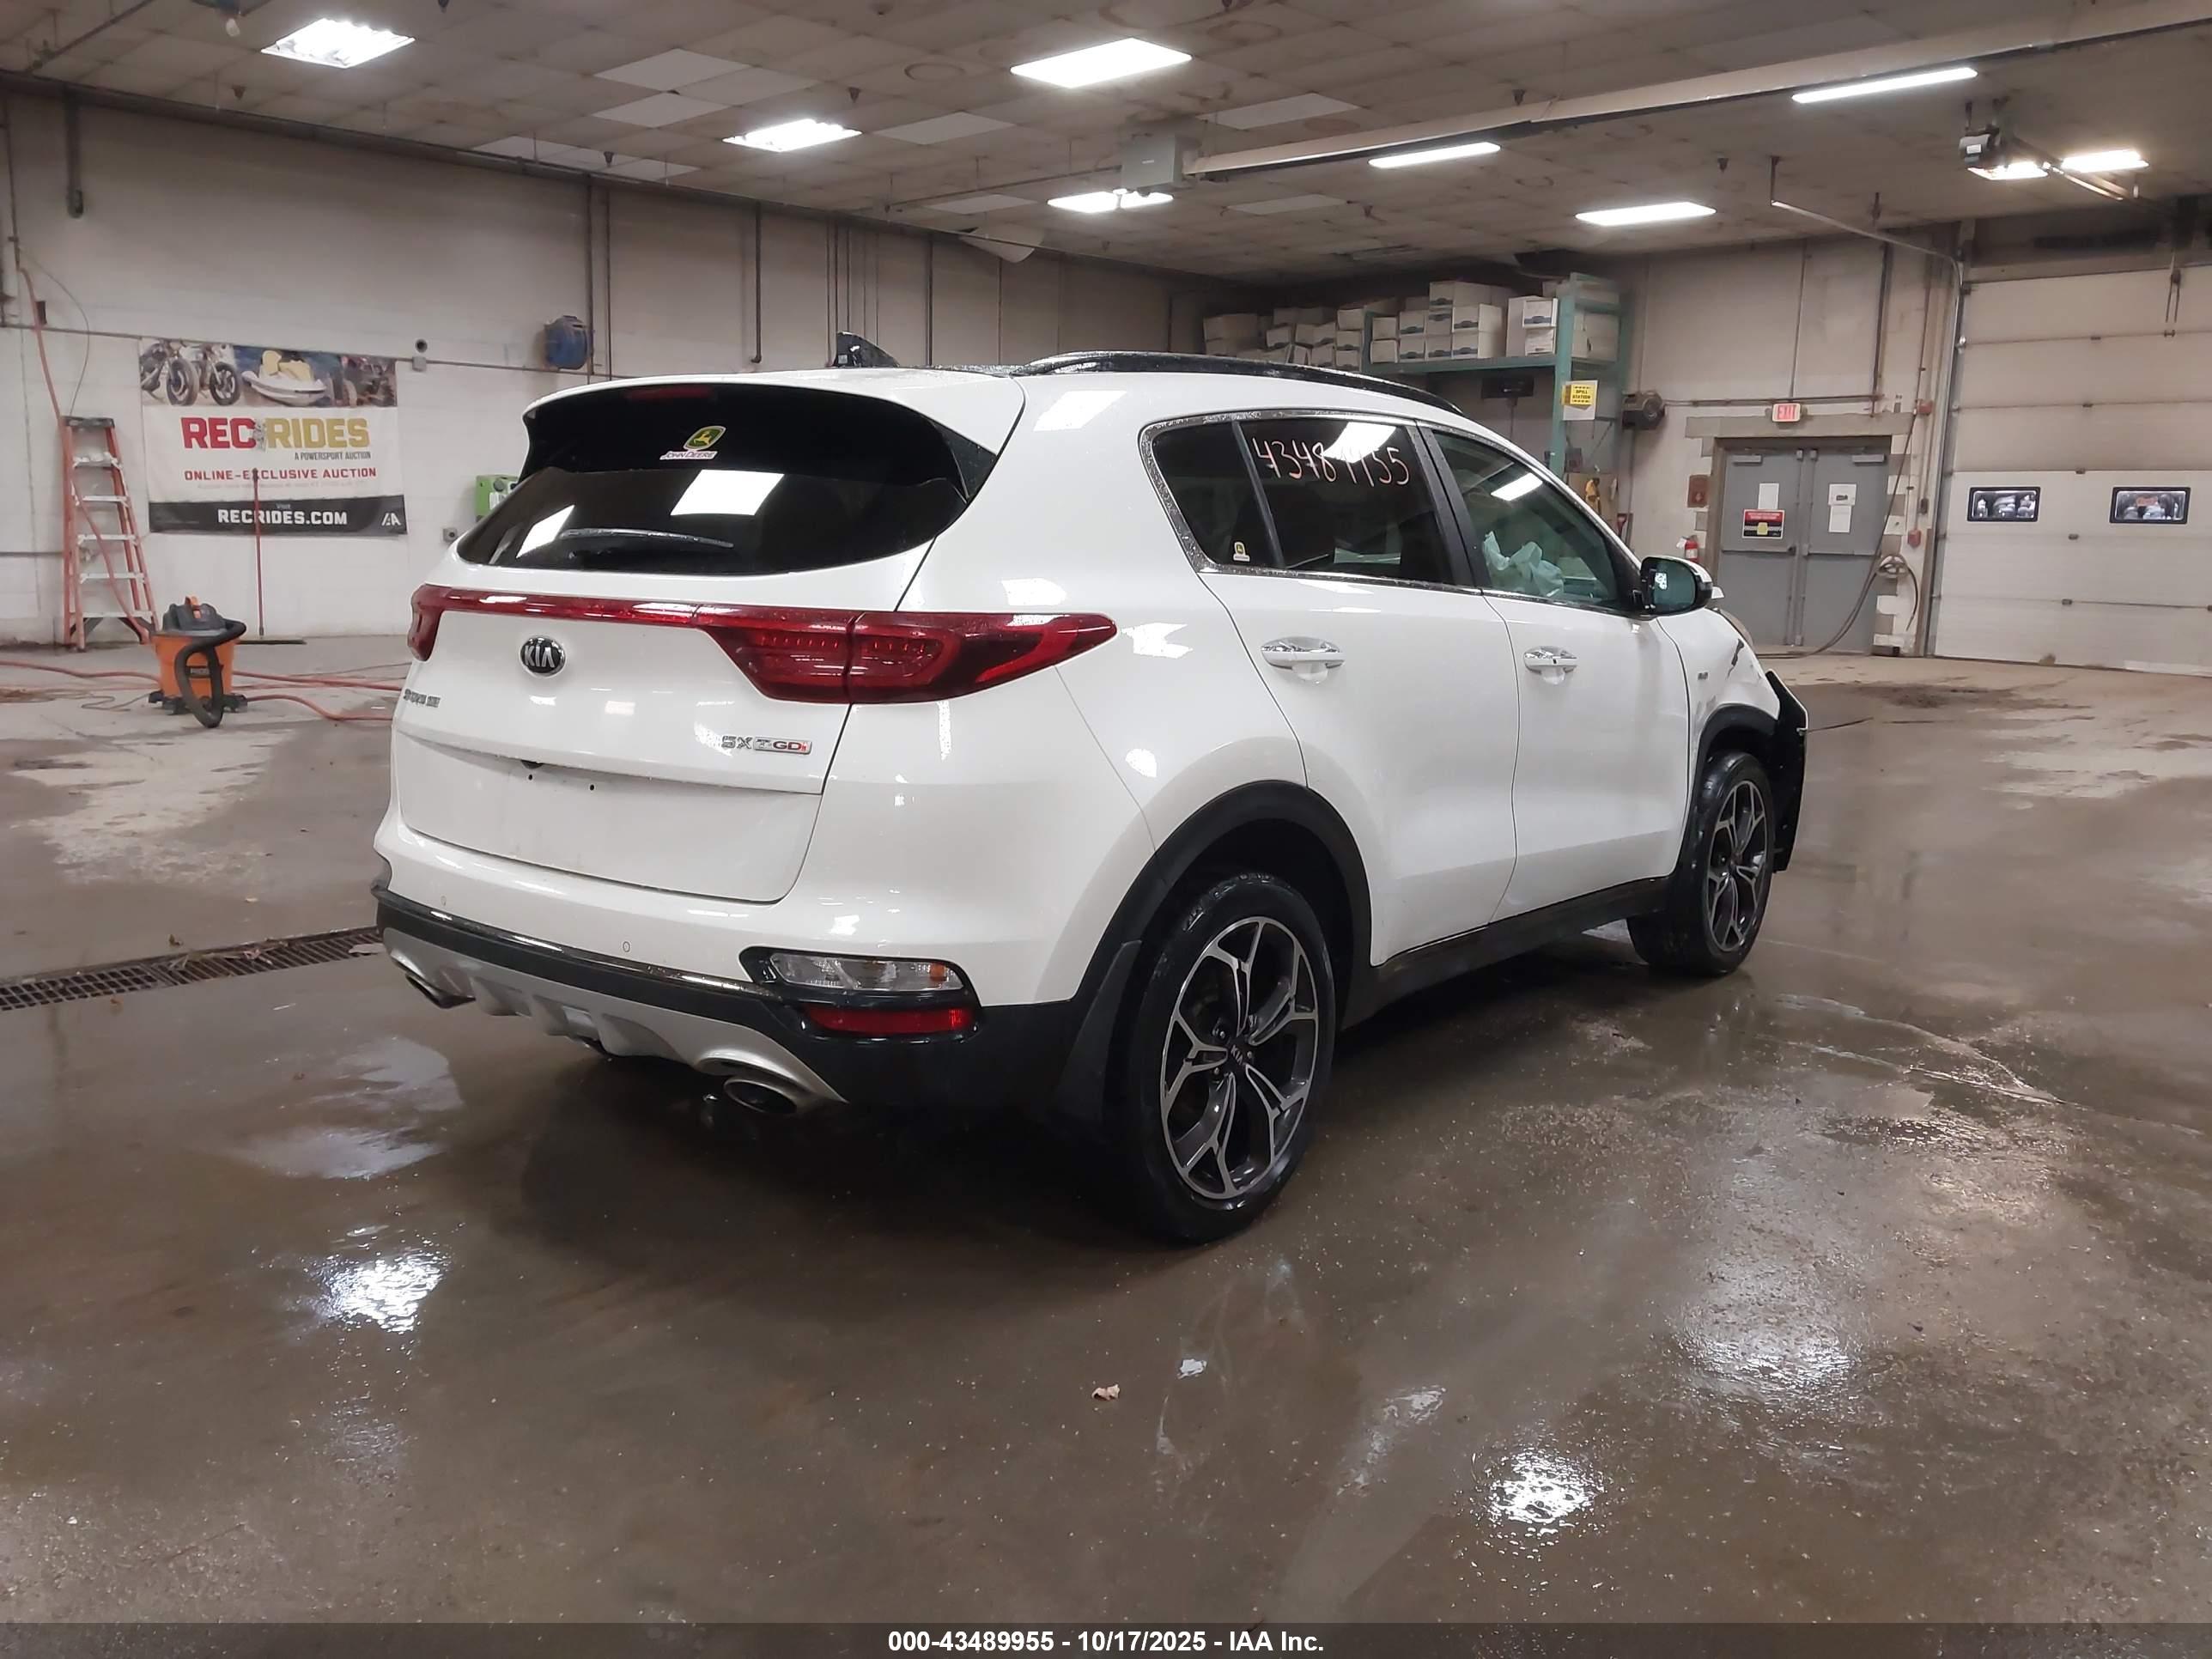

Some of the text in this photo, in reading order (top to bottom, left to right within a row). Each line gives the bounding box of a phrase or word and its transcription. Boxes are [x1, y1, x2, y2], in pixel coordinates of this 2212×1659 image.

[1777, 404, 1797, 420] EXIT
[180, 416, 370, 449] REC RIDES
[295, 451, 371, 461] A POWERSPORT AUCTION
[322, 467, 377, 478] AUCTION
[217, 508, 348, 525] RECRIDES.COM
[525, 645, 556, 668] KIA
[721, 735, 753, 750] SX
[1231, 1044, 1243, 1066] KIA
